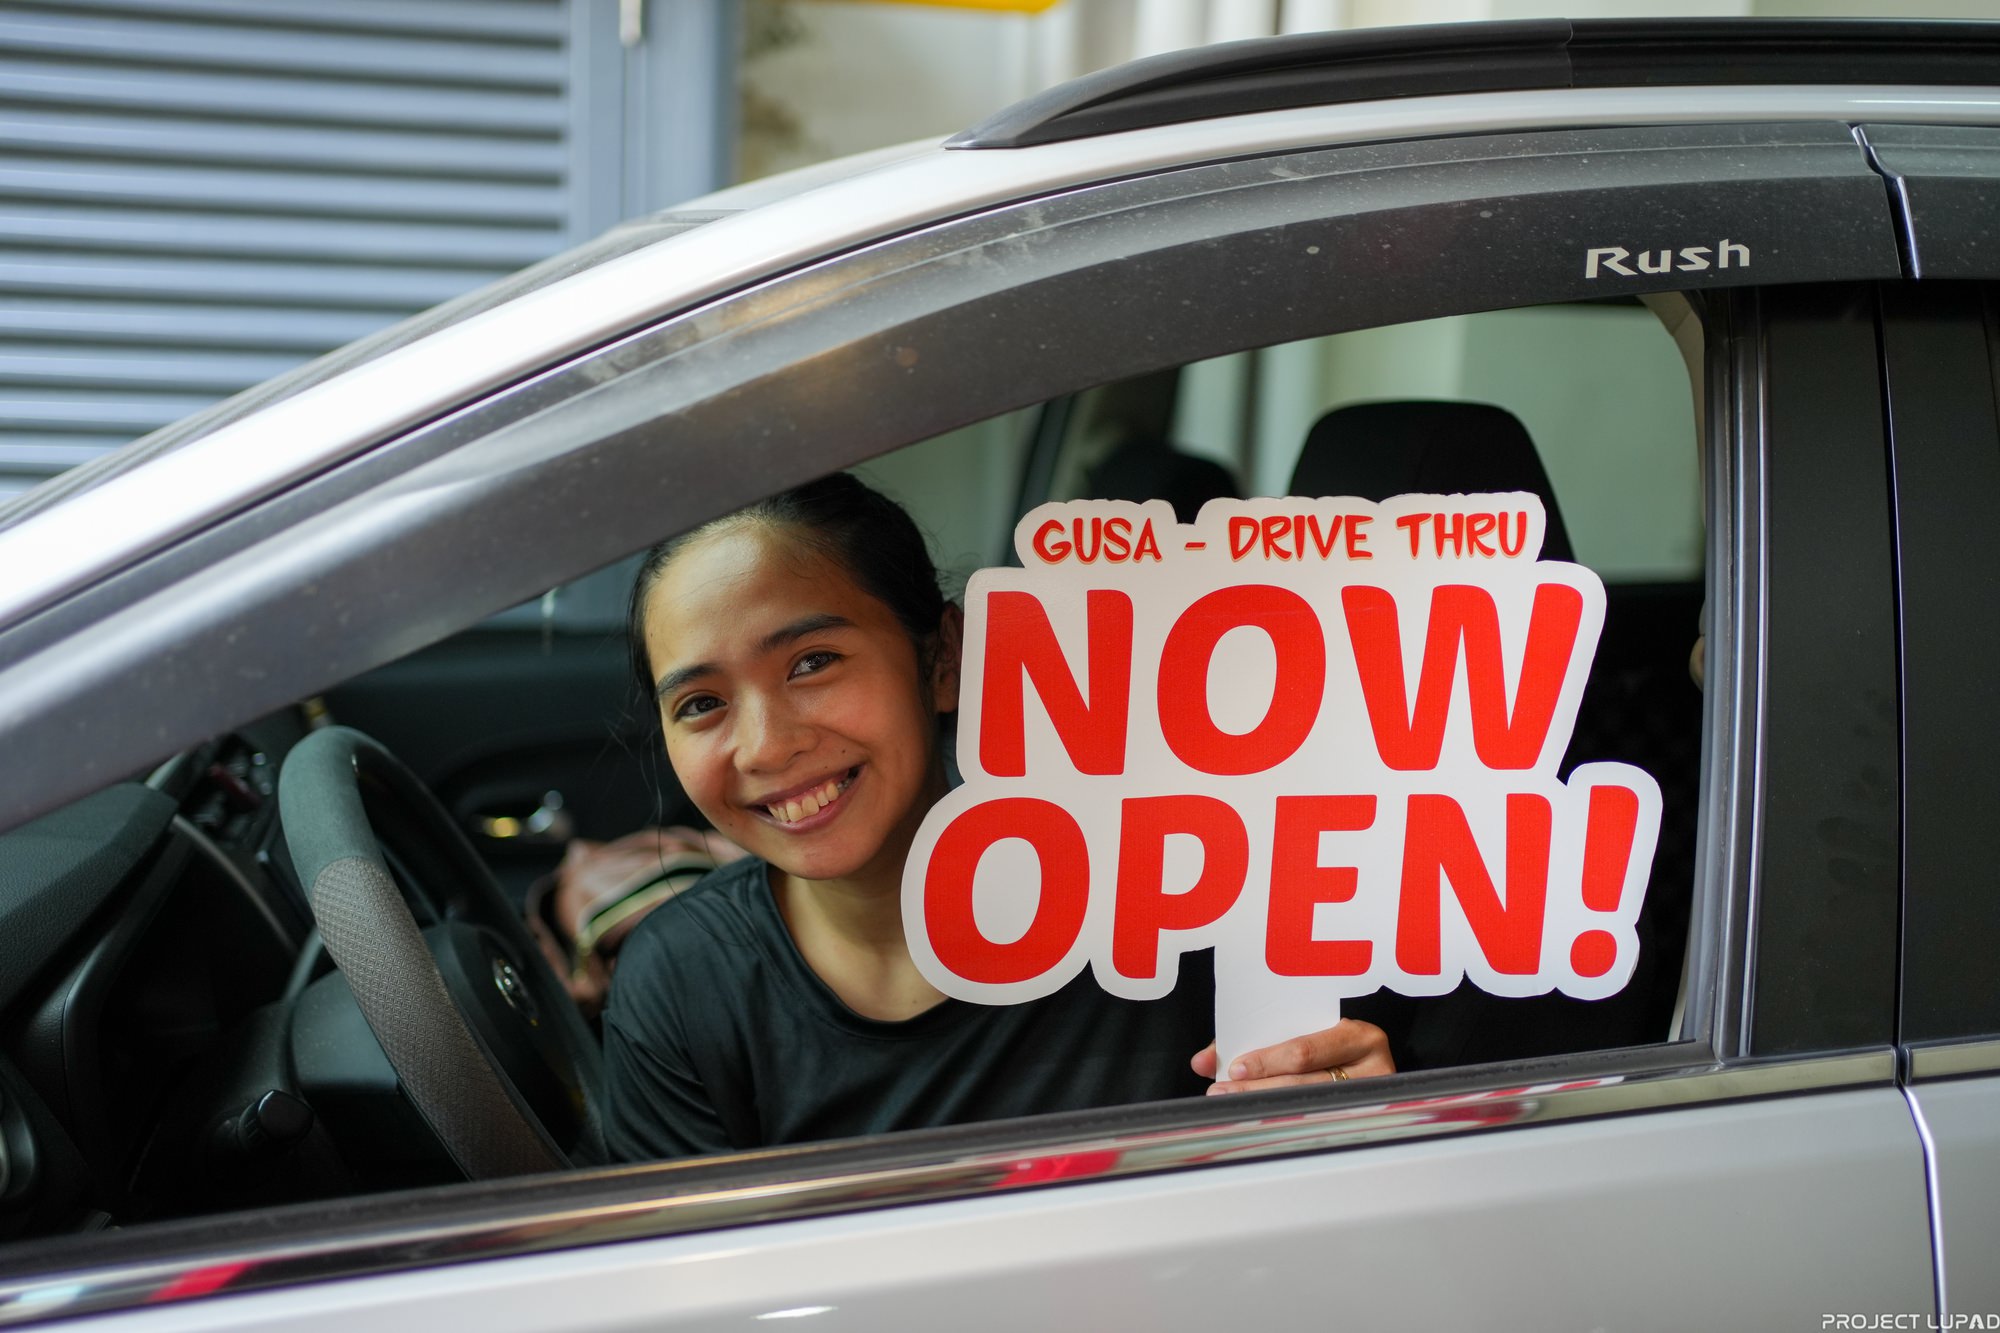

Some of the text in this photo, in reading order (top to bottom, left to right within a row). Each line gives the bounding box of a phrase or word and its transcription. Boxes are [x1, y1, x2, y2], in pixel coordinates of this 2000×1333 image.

[1585, 238, 1750, 279] Rush
[1032, 517, 1163, 564] GUSA
[1227, 514, 1373, 561] DRIVE
[1396, 511, 1528, 559] THRU
[979, 583, 1583, 778] NOW
[923, 785, 1640, 985] OPEN!
